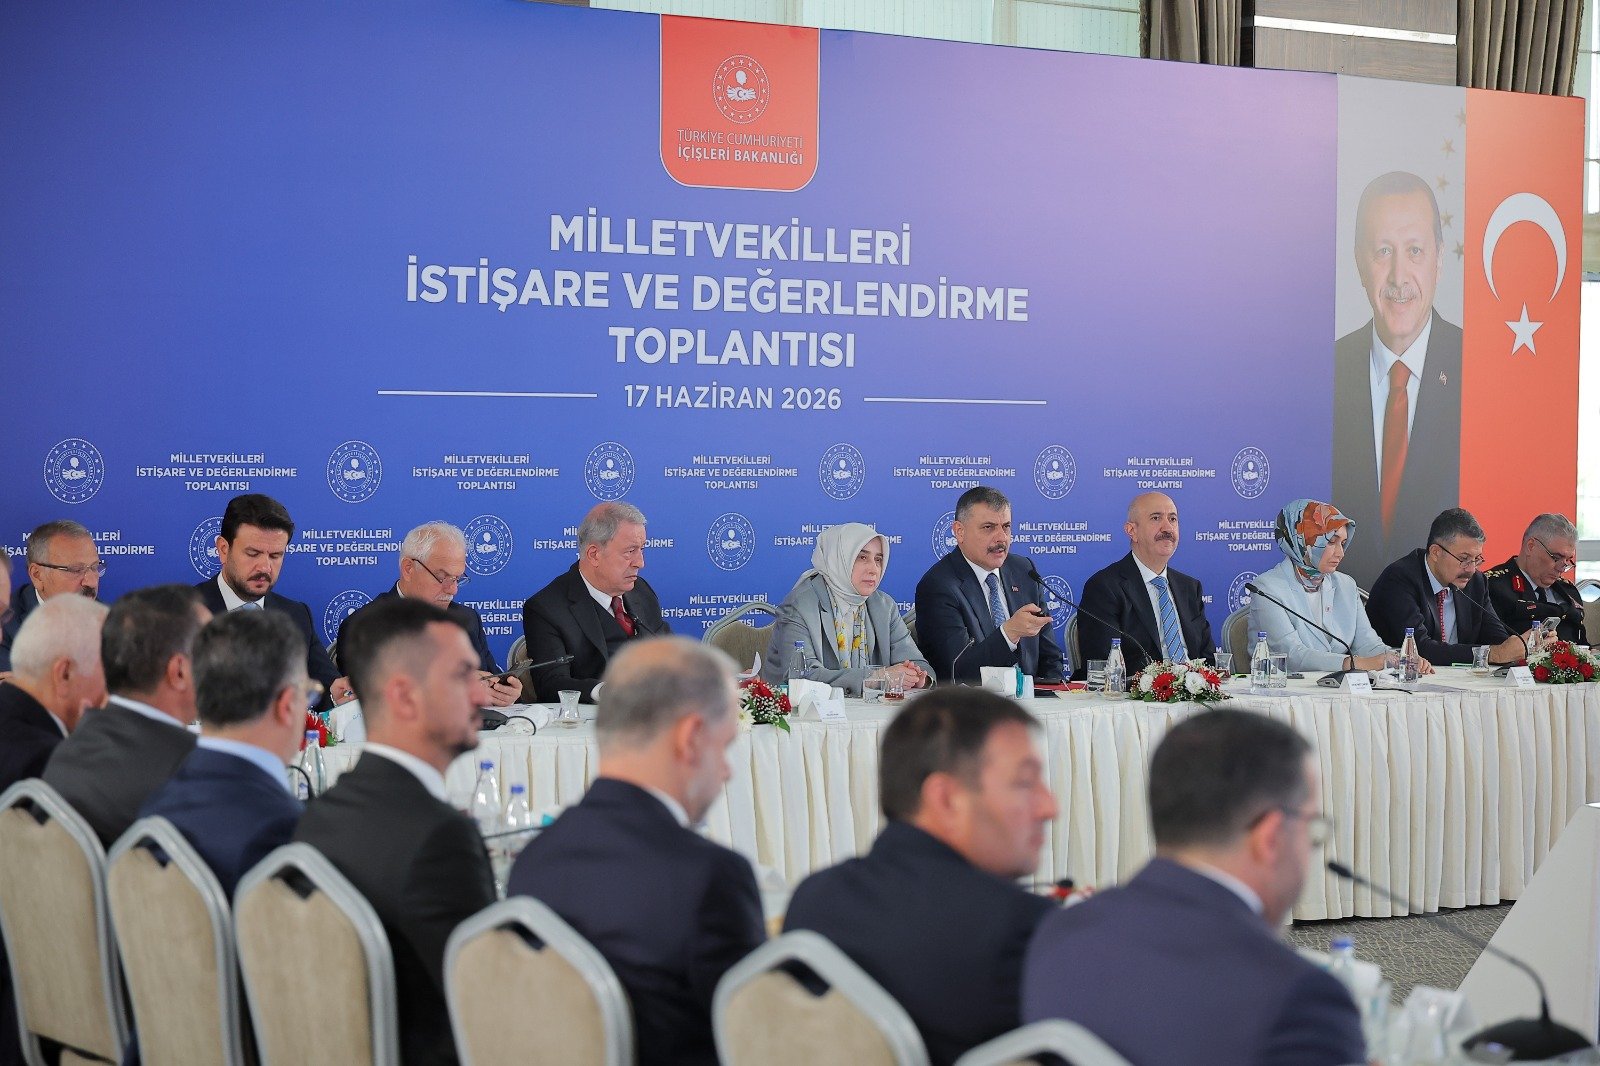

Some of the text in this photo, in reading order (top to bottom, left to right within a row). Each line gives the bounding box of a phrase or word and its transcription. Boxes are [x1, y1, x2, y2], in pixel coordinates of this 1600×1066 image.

[678, 128, 803, 149] TÜRKİYE CUMHURİYETİ
[678, 144, 803, 165] İÇİŞLERİ BAKANLIĞI
[550, 206, 910, 266] MİLLETVEKİLLERİ
[407, 255, 1029, 322] İSTİŞARE VE DEĞERLENDİRME
[608, 326, 855, 368] TOPLANTISI
[624, 381, 842, 410] 17 HAZİRAN 2026
[170, 452, 265, 464] MİLLETVEKİLLERİ
[444, 453, 529, 464] MİLLETVEKİLLERİ
[693, 454, 771, 464] MİLLETVEKİLLERİ
[919, 455, 991, 465] MİLLETVEKİLLERİ
[1127, 456, 1193, 466] MİLLETVEKİLLERİ
[136, 466, 297, 479] İSTİŞARE VE DEĞERLENDİRME
[412, 466, 559, 478] İSTİŞARE VE DEĞERLENDİRME
[664, 467, 706, 478] İSTİŞARE
[722, 466, 798, 477] DEĞERLENDİRME
[893, 467, 931, 477] İSTİŞARE
[946, 467, 1016, 477] DEĞERLENDİRME
[1103, 468, 1138, 478] İSTİŞARE
[1152, 468, 1216, 477] DEĞERLENDİRME
[185, 481, 249, 491] TOPLANTISI
[457, 481, 516, 490] TOPLANTISI
[705, 480, 758, 489] TOPLANTISI
[931, 480, 980, 489] TOPLANTISI
[1137, 481, 1182, 489] TOPLANTISI
[1019, 521, 1088, 531] MİLLETVEKİLLERİ
[1219, 519, 1274, 529] MİLLETVEKİLLE
[302, 528, 392, 539] MİLLETVEKİLLERİ
[1044, 533, 1111, 542] DEĞERLENDİRME
[1195, 531, 1275, 541] İSTİŞARE VE DEĞERLE
[533, 538, 577, 550] İSTİŞARE
[774, 536, 813, 547] İSTİŞARE
[1228, 543, 1271, 551] TOPLANTISI
[97, 543, 155, 555] LENDİRME
[286, 541, 403, 554] İŞARE VE DEĞERLENDİ
[1029, 546, 1076, 554] TOPLANTISI
[316, 556, 378, 566] TOPLANTISI
[689, 592, 768, 604] MİLLETVEKİLLERİ
[661, 607, 703, 618] İSTİŞARE
[705, 608, 717, 616] VE
